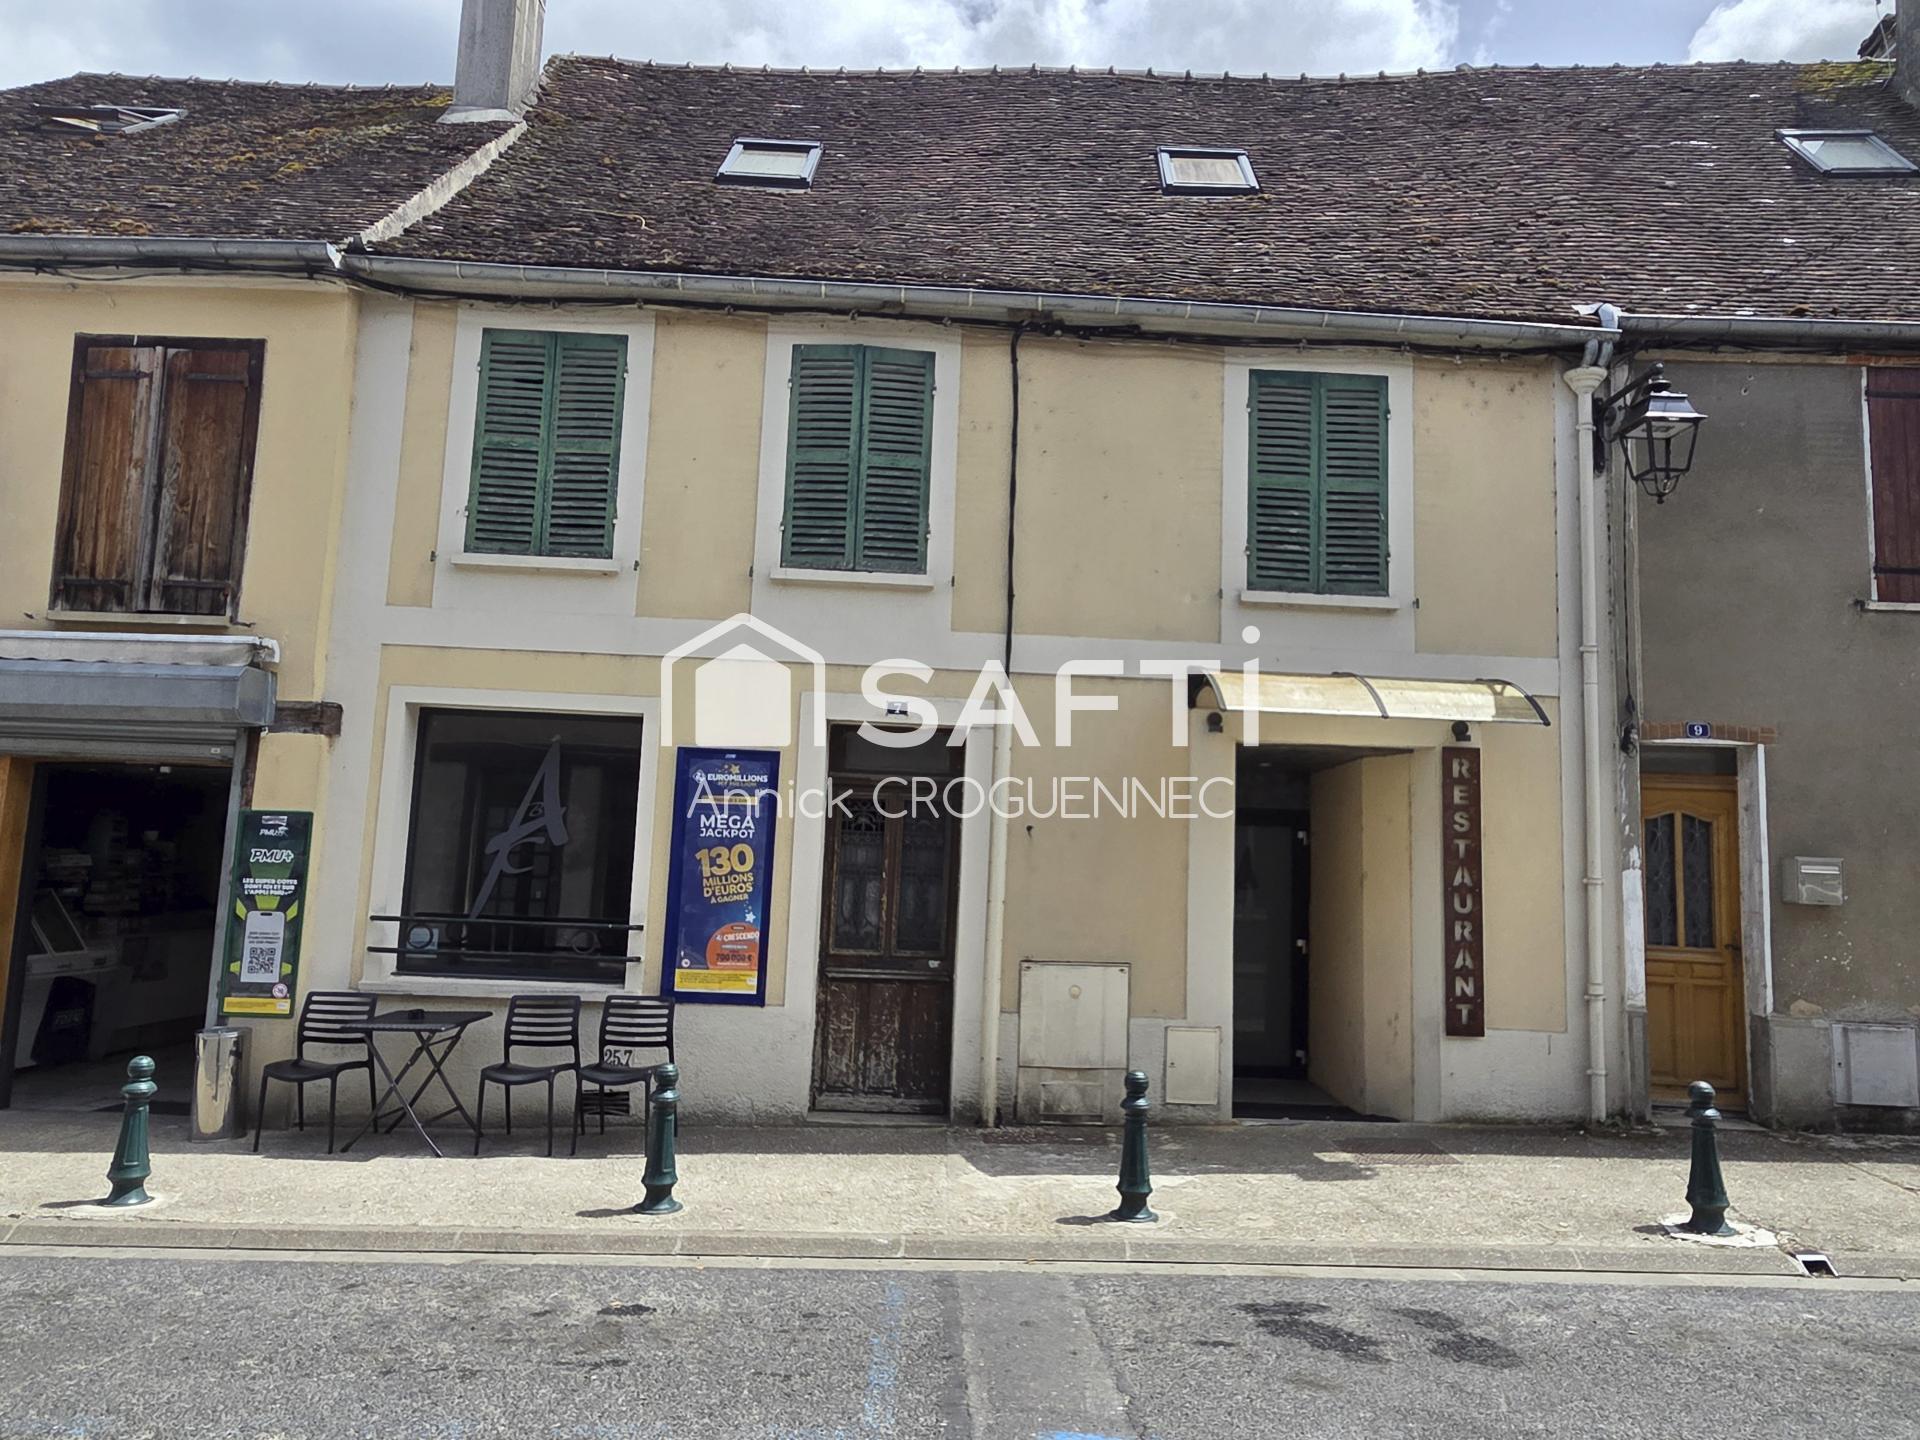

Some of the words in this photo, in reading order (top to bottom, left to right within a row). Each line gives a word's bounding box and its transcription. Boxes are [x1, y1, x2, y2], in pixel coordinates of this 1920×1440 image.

[893, 703, 902, 714] 7
[1693, 725, 1703, 736] 9
[707, 773, 769, 783] EUROMILLIONS
[700, 814, 755, 829] MEGA
[700, 828, 756, 839] JACKPOT
[695, 843, 754, 877] 130
[703, 872, 754, 888] MILLIONS
[703, 882, 753, 898] D'EUROS
[1451, 757, 1475, 1026] RESTAURANT
[717, 893, 750, 903] GAGNER
